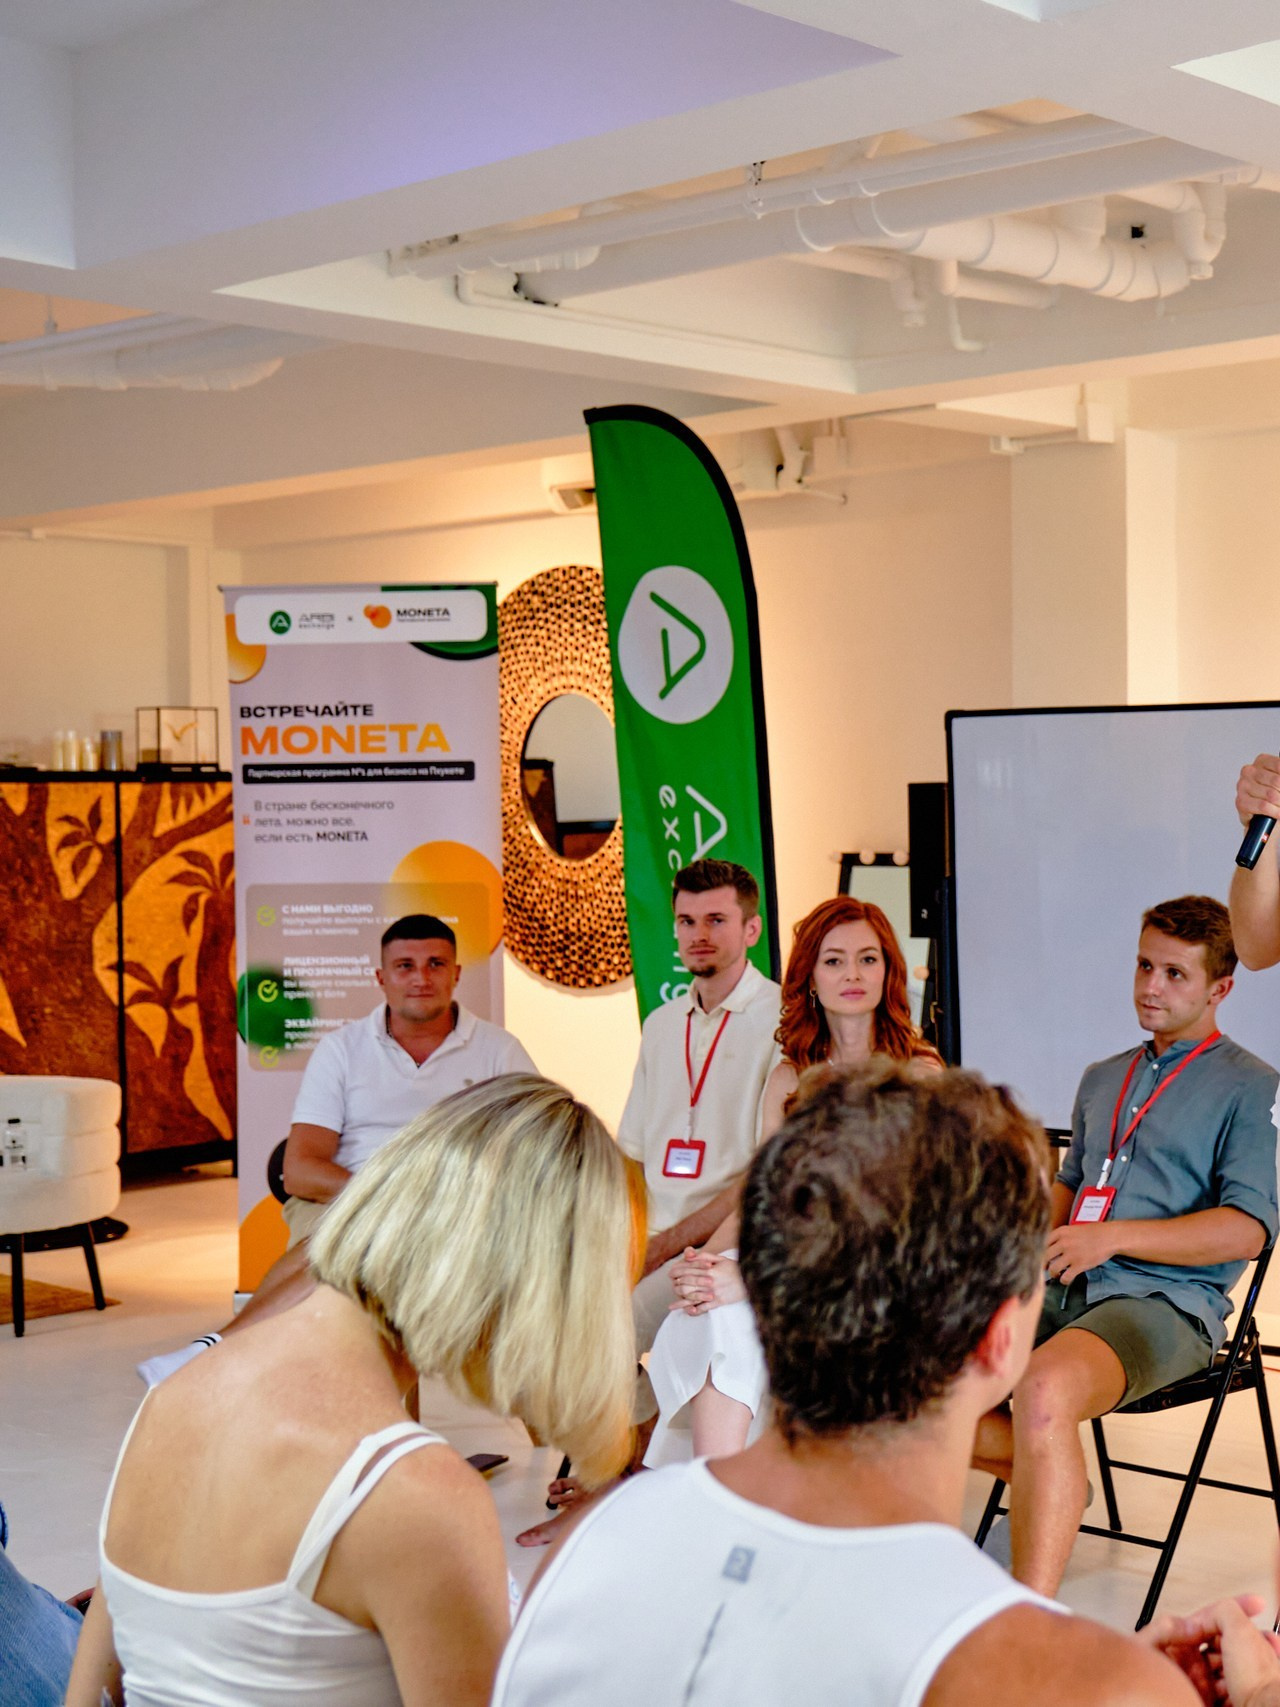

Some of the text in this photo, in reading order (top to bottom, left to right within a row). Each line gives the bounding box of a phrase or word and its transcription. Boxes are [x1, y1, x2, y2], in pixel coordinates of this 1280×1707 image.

[397, 608, 450, 617] MONETA
[240, 701, 374, 718] ВСТРЕЧАЙТЕ
[240, 723, 452, 755] MONETA
[254, 800, 394, 813] В стране бесконечного
[286, 817, 329, 826] можно
[254, 831, 368, 842] если есть MONETA
[282, 904, 373, 915] С НАМИ ВЫГОДНО
